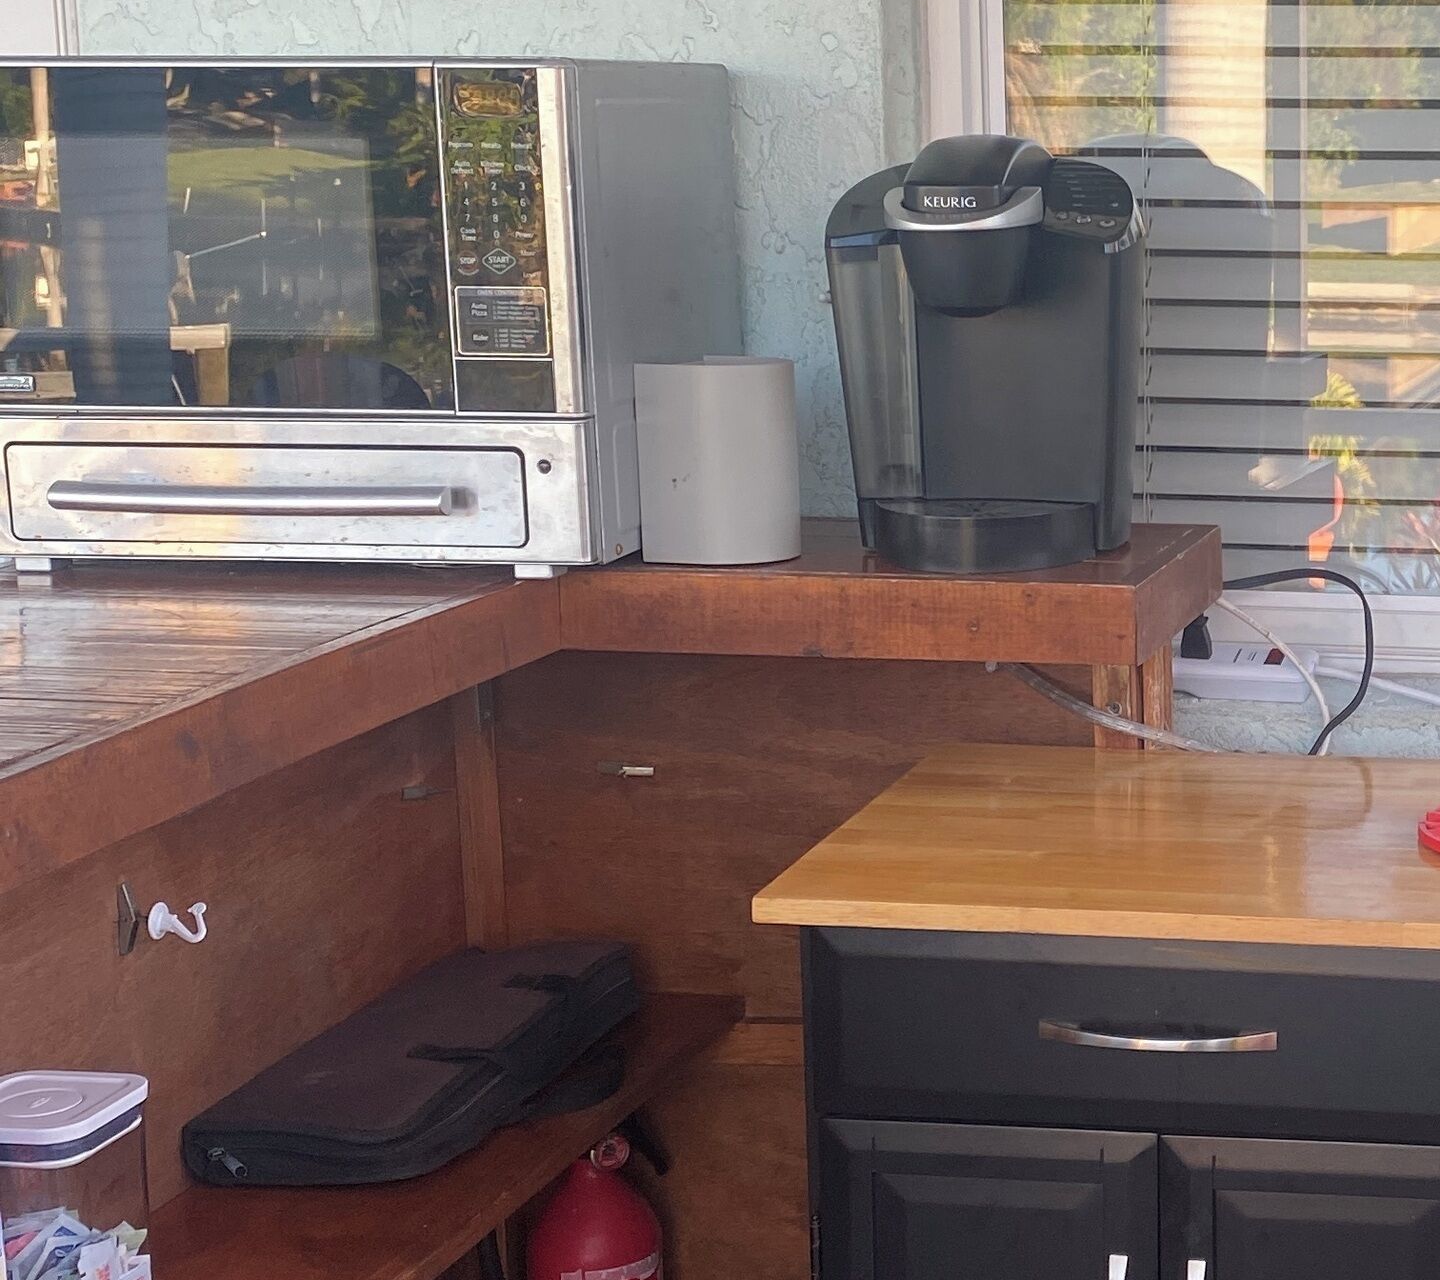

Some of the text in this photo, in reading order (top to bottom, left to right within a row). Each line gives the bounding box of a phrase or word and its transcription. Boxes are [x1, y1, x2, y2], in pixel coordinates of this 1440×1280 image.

[923, 195, 977, 208] KEURIG
[460, 256, 476, 265] STOP
[488, 256, 510, 265] START
